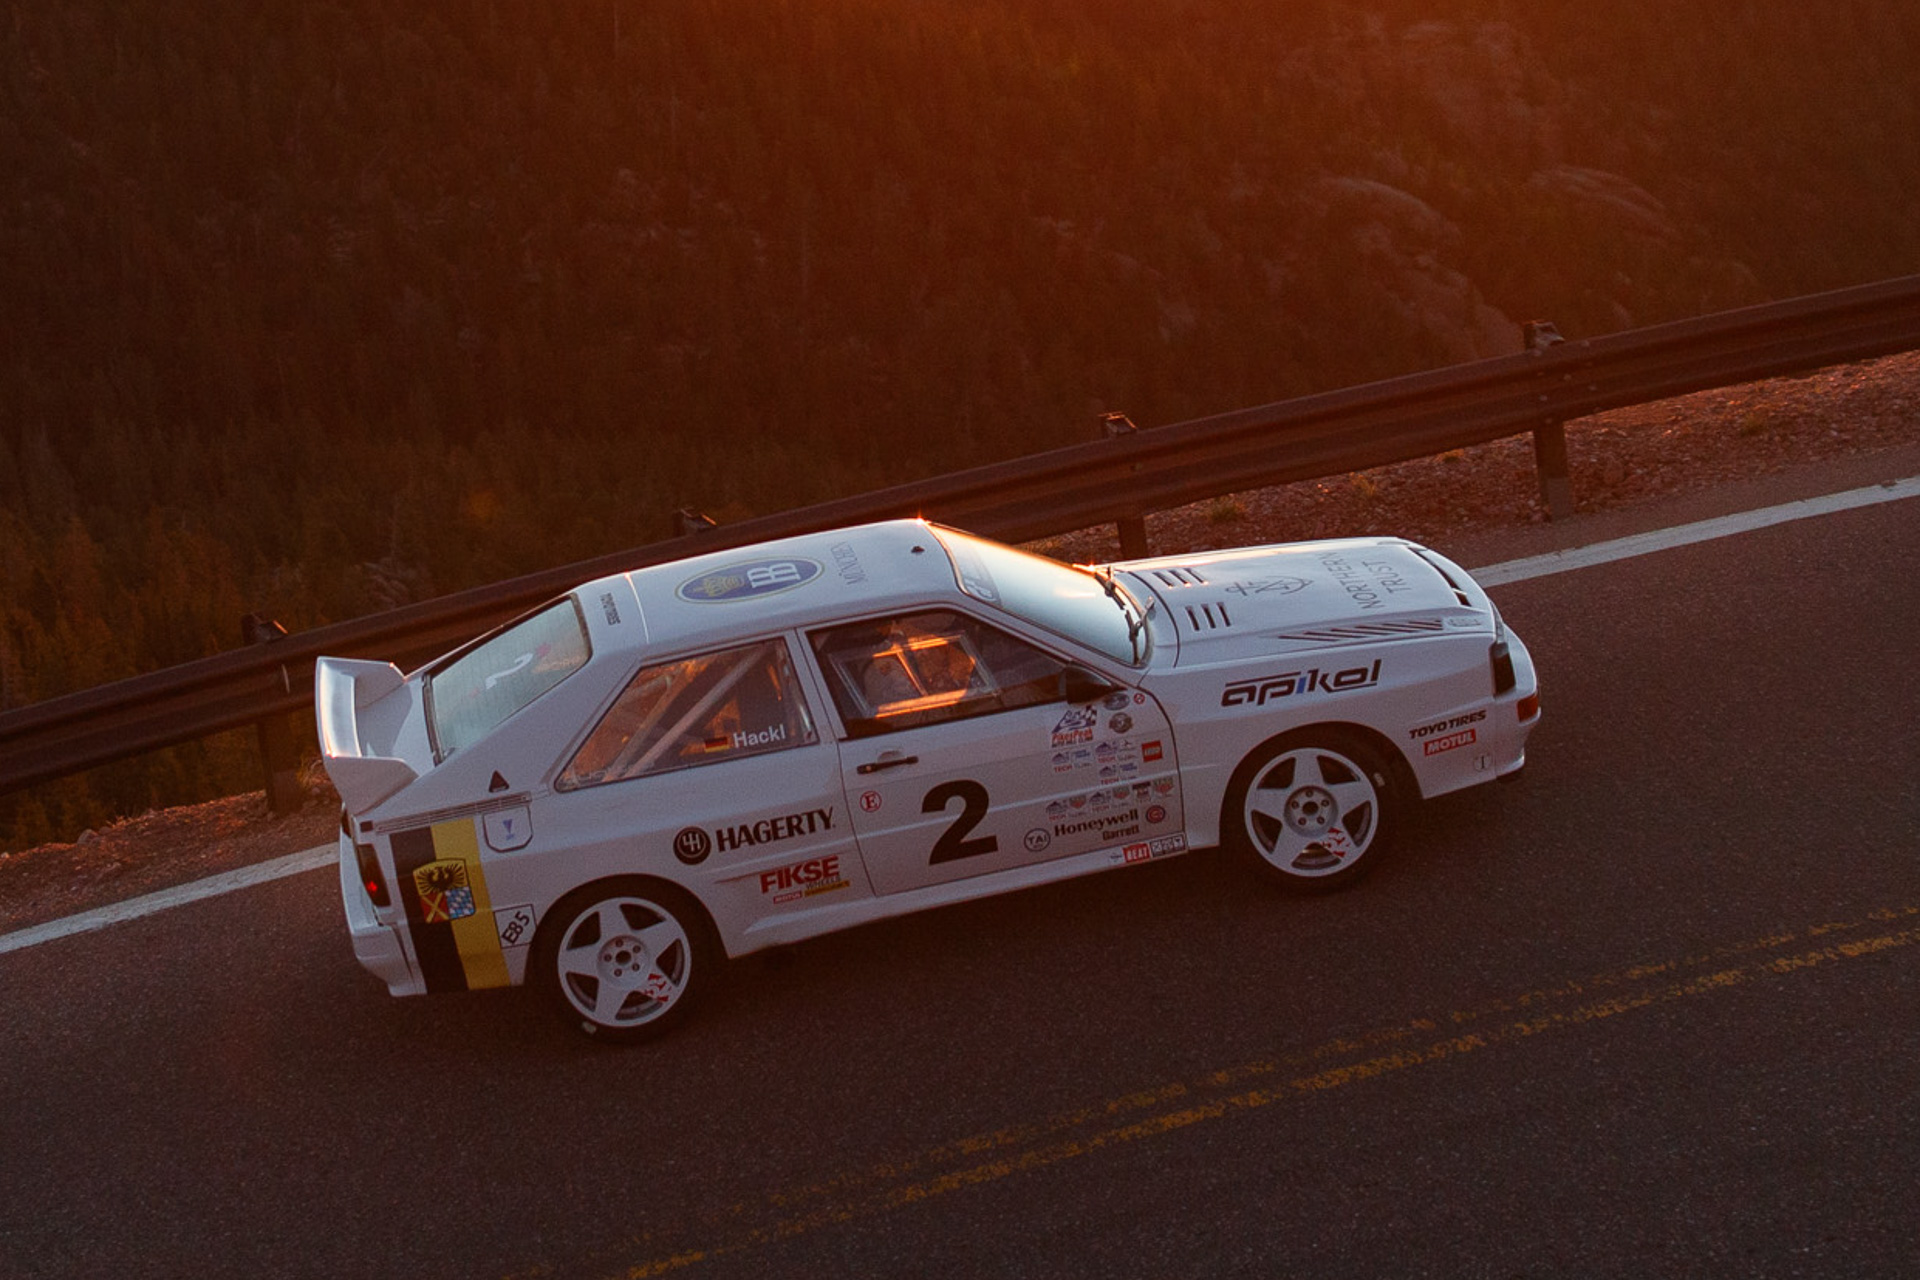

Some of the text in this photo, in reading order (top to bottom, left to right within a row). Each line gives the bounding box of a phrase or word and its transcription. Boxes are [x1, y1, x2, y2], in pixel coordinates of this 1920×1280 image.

[1317, 551, 1386, 610] NORTHERN
[1361, 560, 1412, 594] TRUST
[1220, 658, 1383, 708] apikol
[733, 723, 787, 749] Hackl
[1408, 709, 1487, 740] TOYO TIRES
[1427, 731, 1475, 755] MOTUL
[716, 805, 834, 853] HAGERTY
[921, 779, 999, 867] 2
[1054, 809, 1139, 838] Honeywell
[1102, 824, 1140, 842] Garrett
[760, 855, 840, 895] FIKSE
[501, 911, 531, 944] E85
